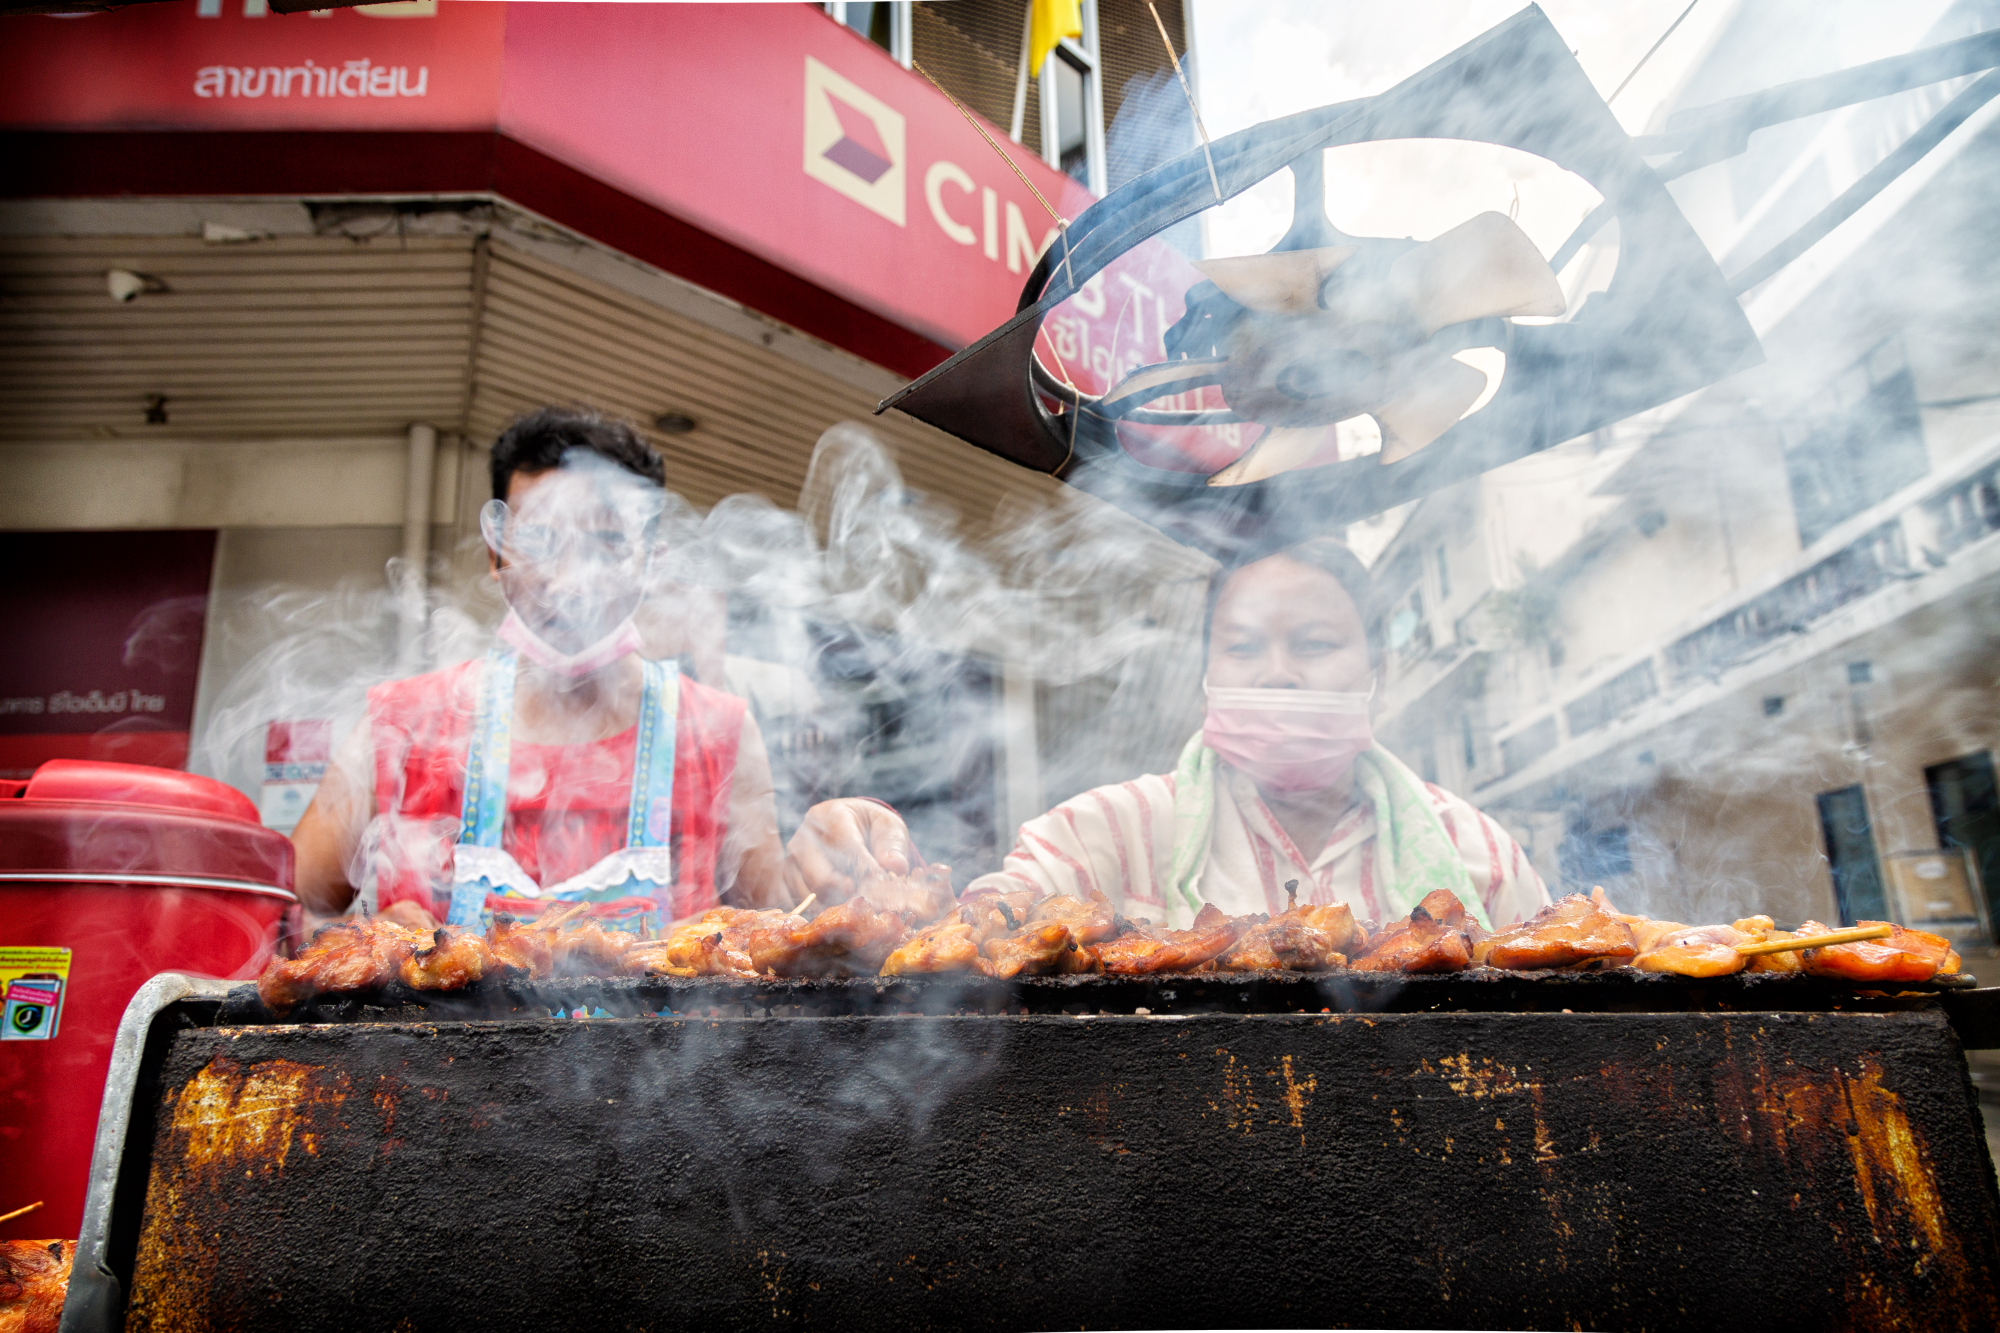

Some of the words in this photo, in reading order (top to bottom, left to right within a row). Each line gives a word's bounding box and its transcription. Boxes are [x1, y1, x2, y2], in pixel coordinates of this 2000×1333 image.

[193, 58, 430, 98] สาขาท่าเตียน
